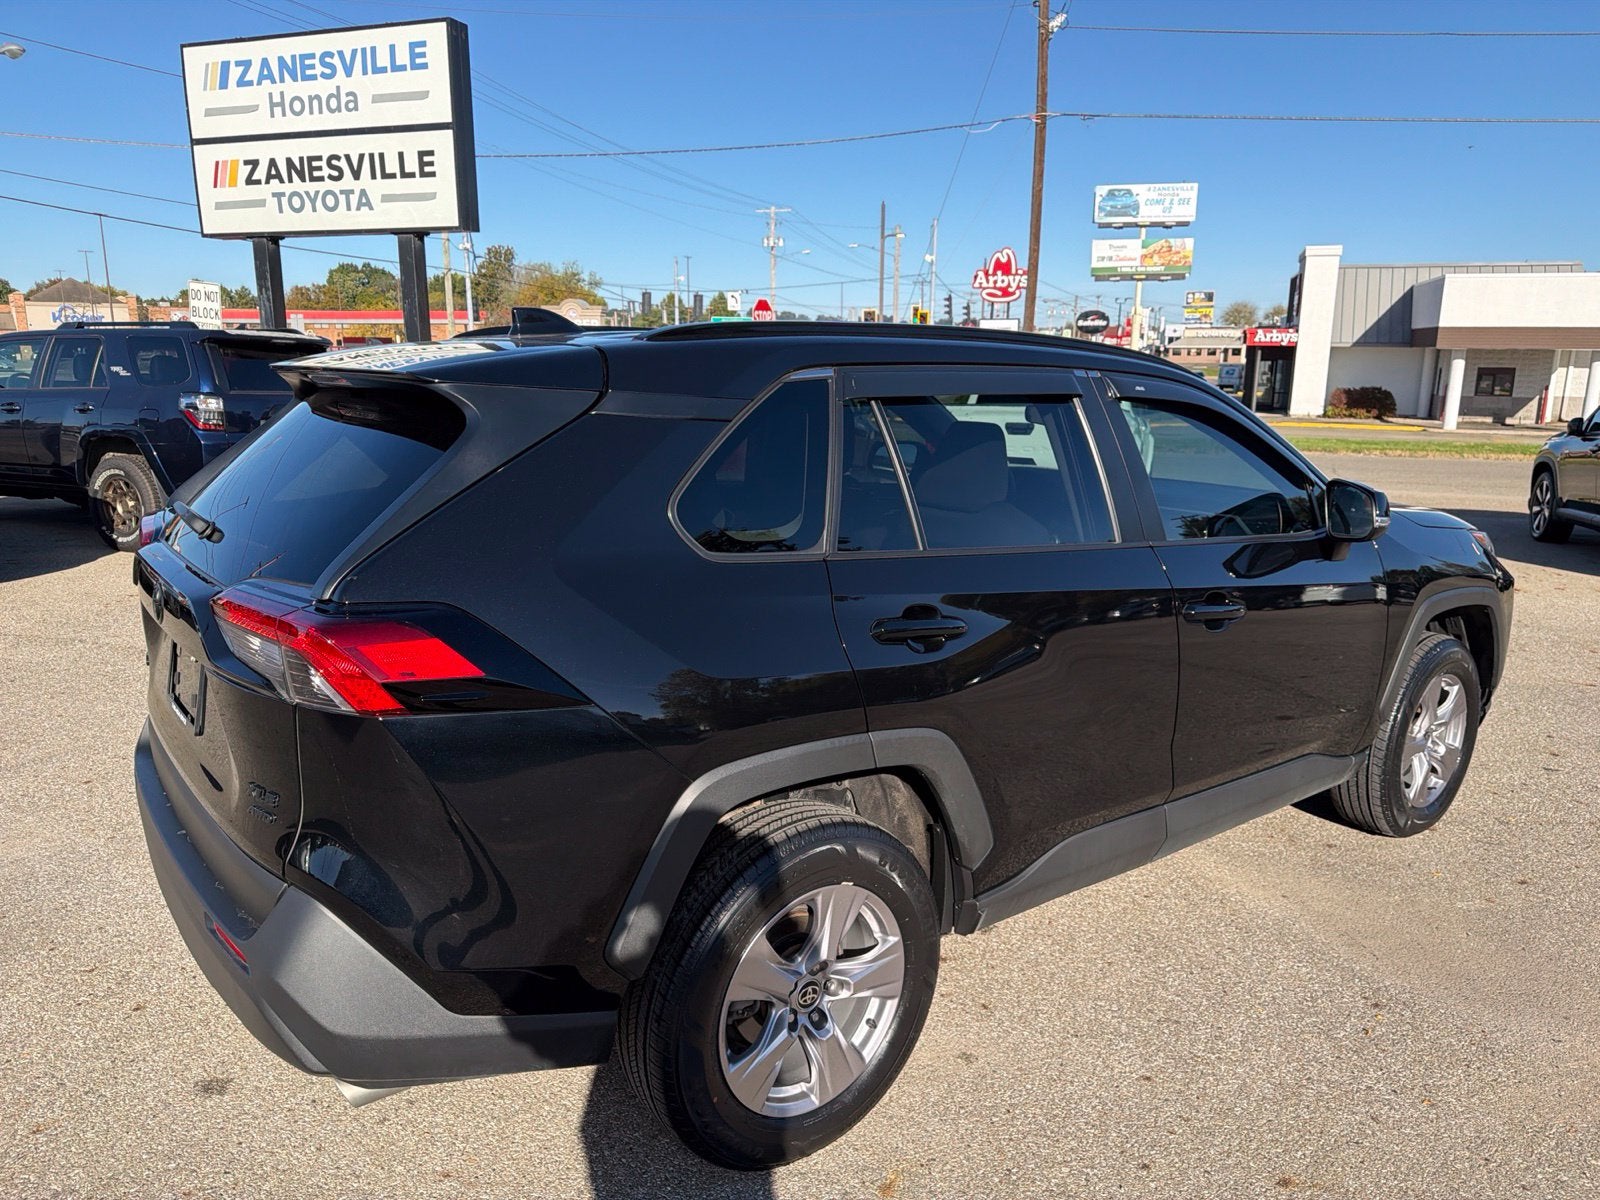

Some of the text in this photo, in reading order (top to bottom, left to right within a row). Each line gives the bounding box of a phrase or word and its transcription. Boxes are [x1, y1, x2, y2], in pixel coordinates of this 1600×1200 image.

[234, 40, 429, 88] ZANESVILLE
[268, 85, 359, 118] Honda
[243, 150, 437, 186] ZANESVILLE
[271, 188, 374, 214] TOYOTA
[1144, 197, 1192, 206] COME & SEE
[1162, 206, 1173, 214] US
[973, 269, 1028, 292] Arby's
[190, 288, 219, 303] DO NOT
[191, 305, 220, 320] BLOCK
[1253, 328, 1299, 346] Arby's
